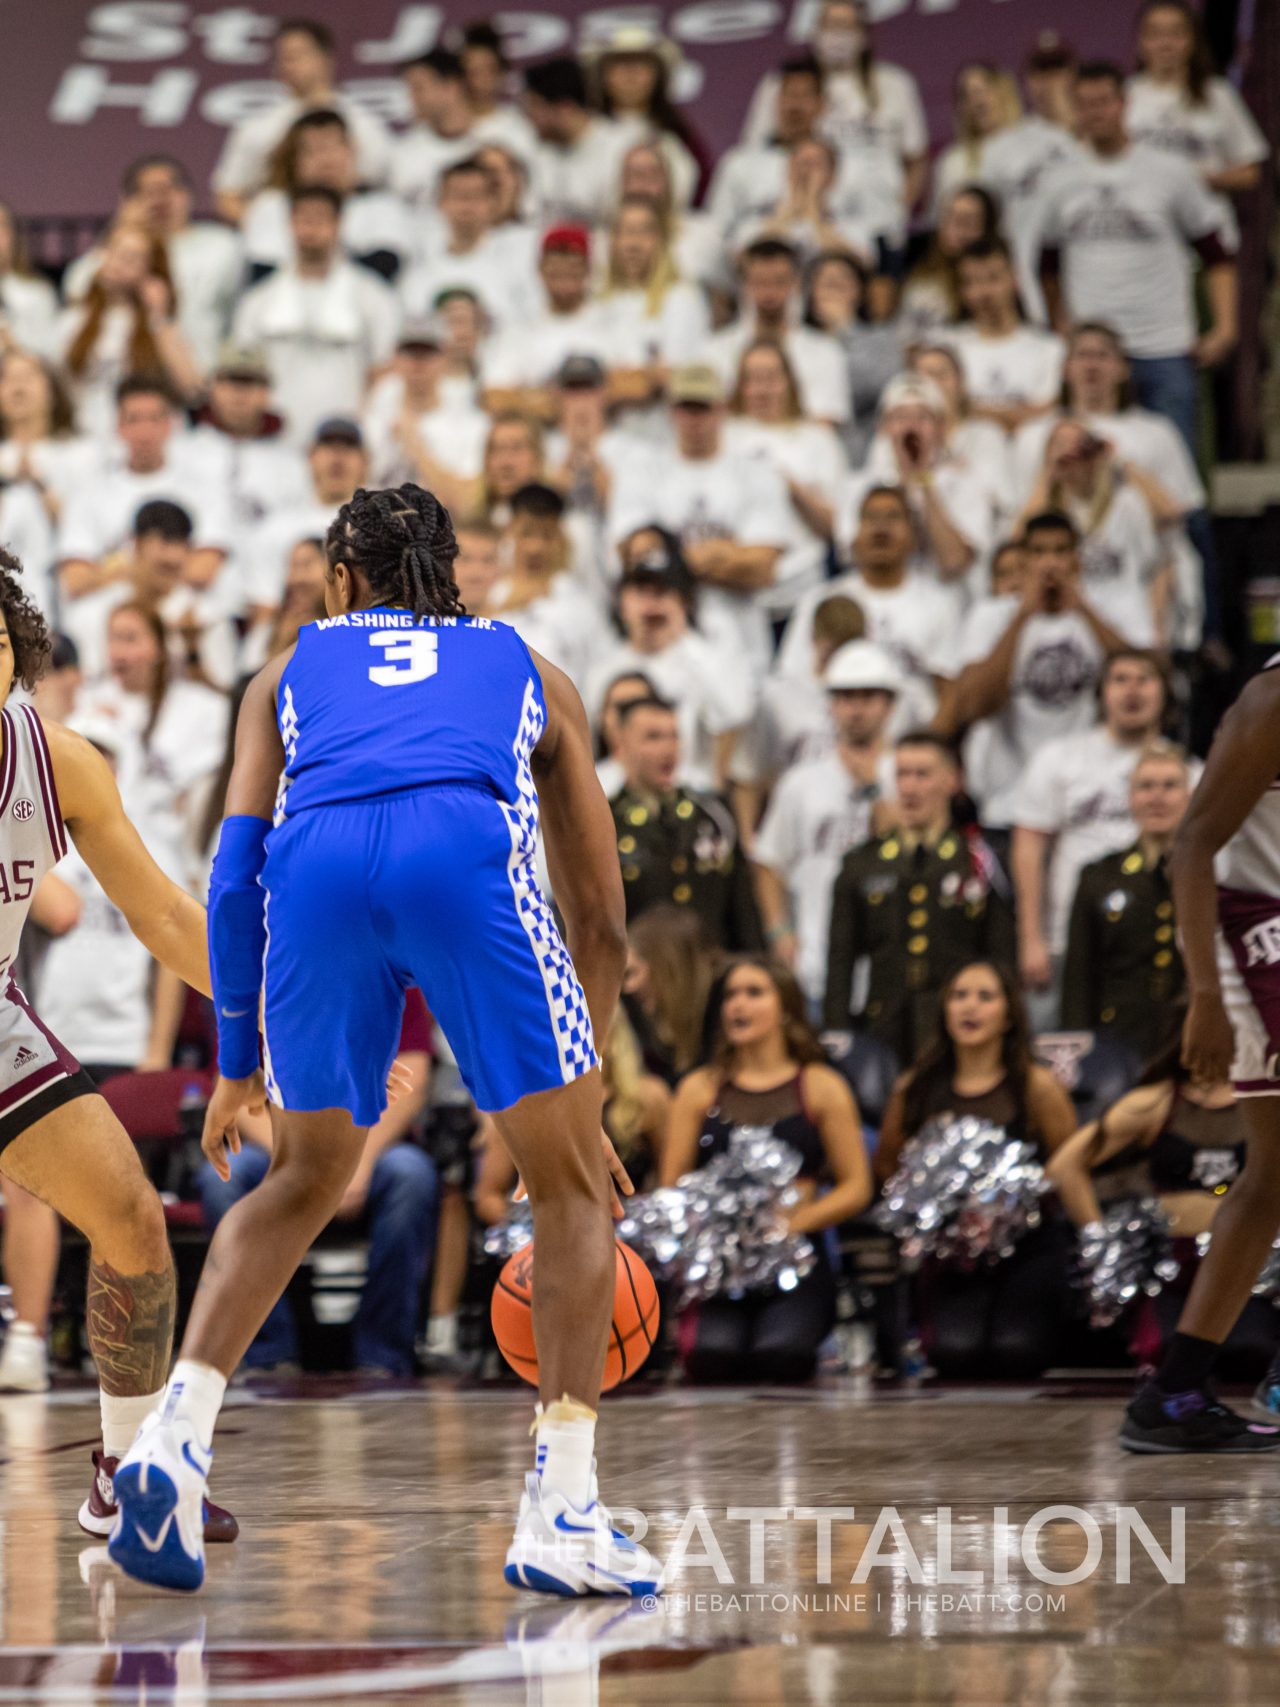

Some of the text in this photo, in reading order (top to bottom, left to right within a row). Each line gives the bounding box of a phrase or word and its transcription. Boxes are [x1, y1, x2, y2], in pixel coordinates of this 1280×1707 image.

[81, 1, 276, 64] St
[315, 613, 457, 631] WASHINGTON
[368, 631, 438, 687] 3
[15, 800, 33, 819] SEC
[13, 1052, 39, 1070] adidas
